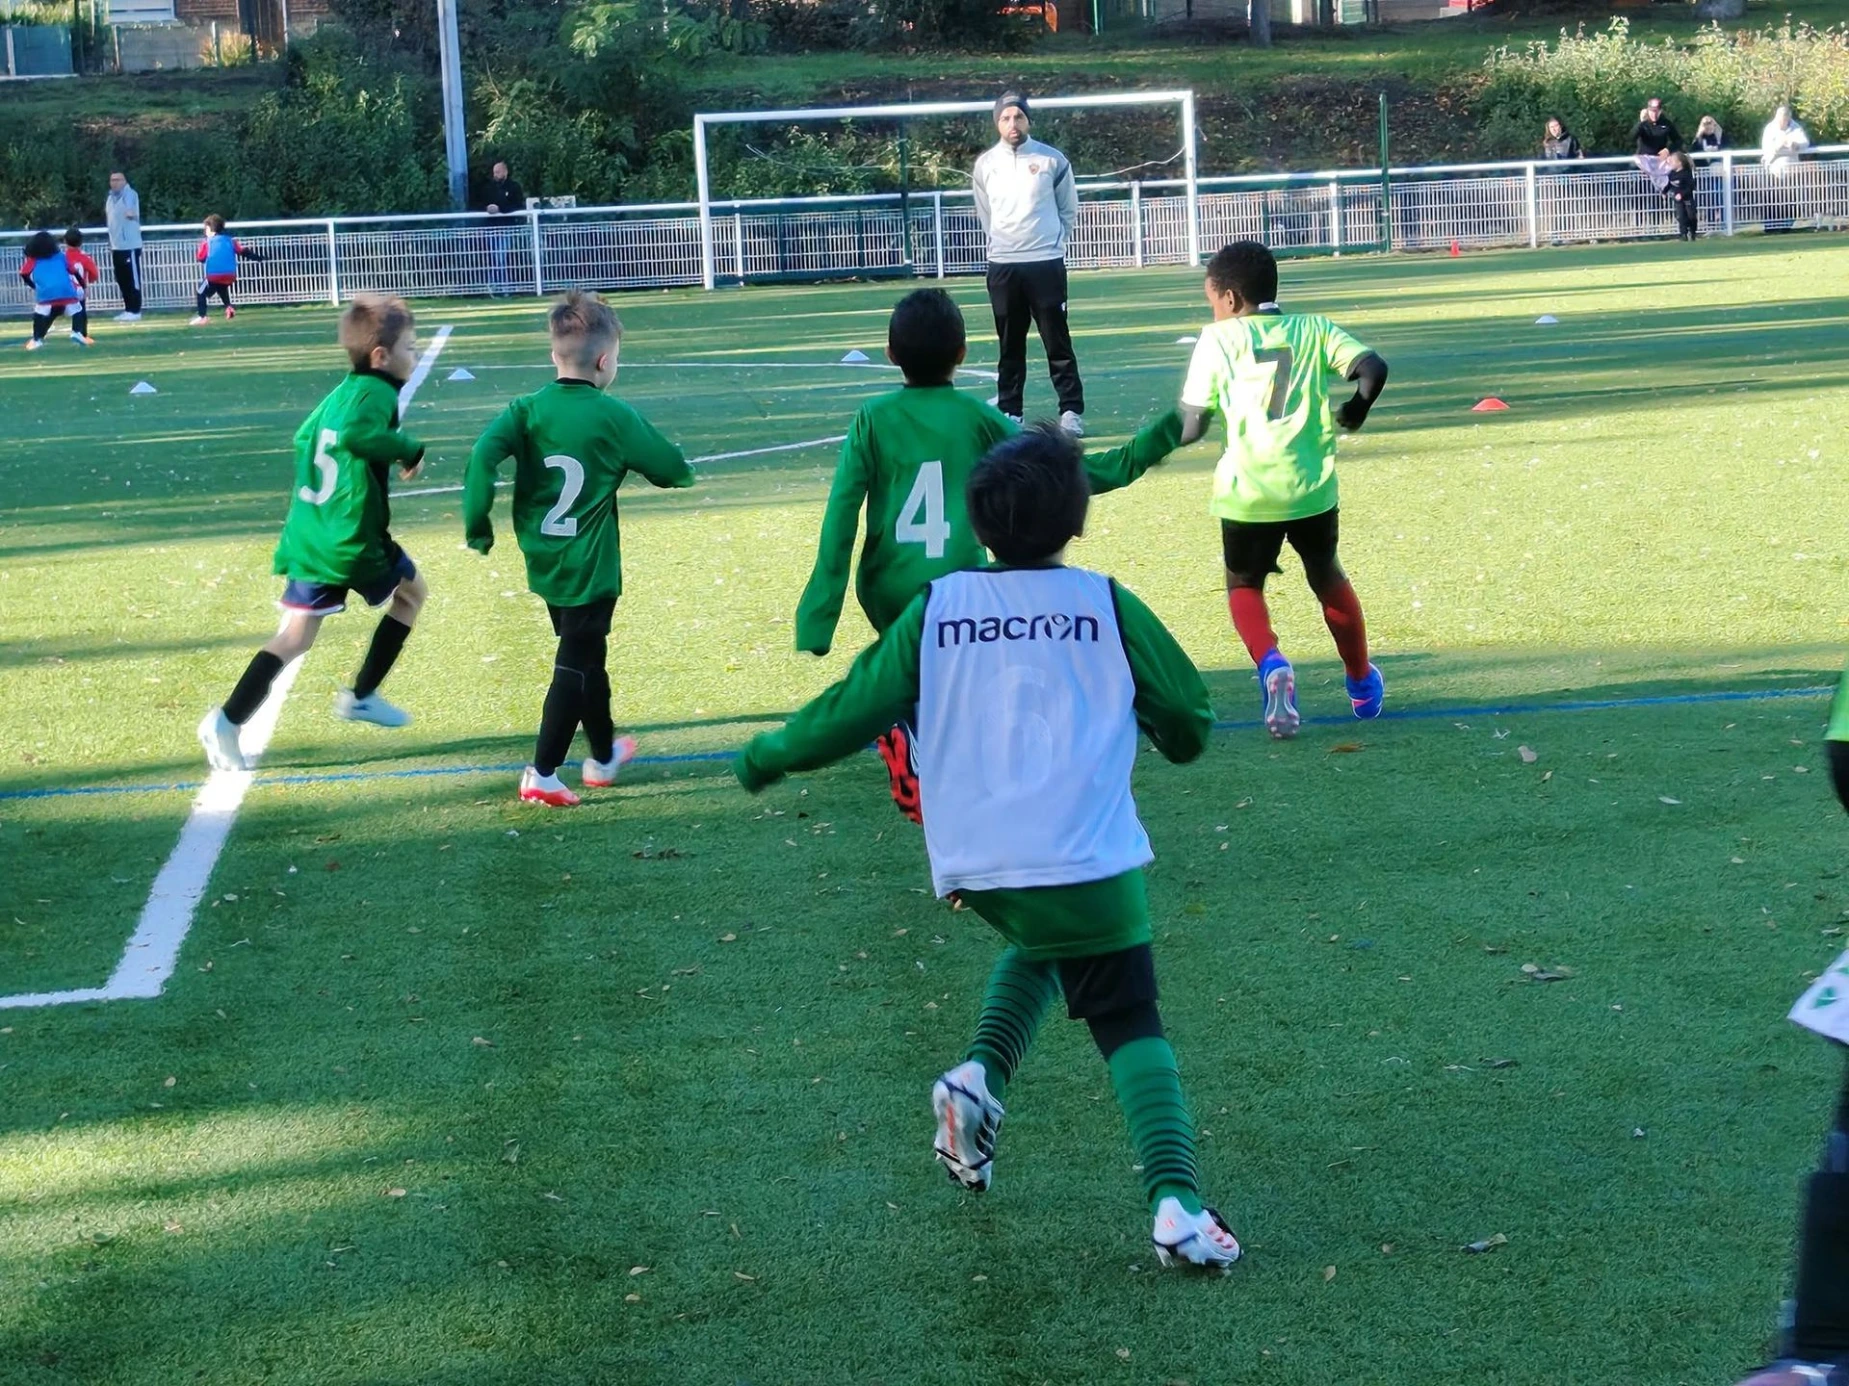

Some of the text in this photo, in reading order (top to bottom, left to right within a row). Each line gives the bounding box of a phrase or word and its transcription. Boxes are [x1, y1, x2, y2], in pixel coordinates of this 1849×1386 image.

[1255, 347, 1293, 420] 7
[300, 428, 338, 505] 5
[541, 455, 585, 536] 2
[896, 460, 951, 558] 4
[938, 613, 1099, 648] macron
